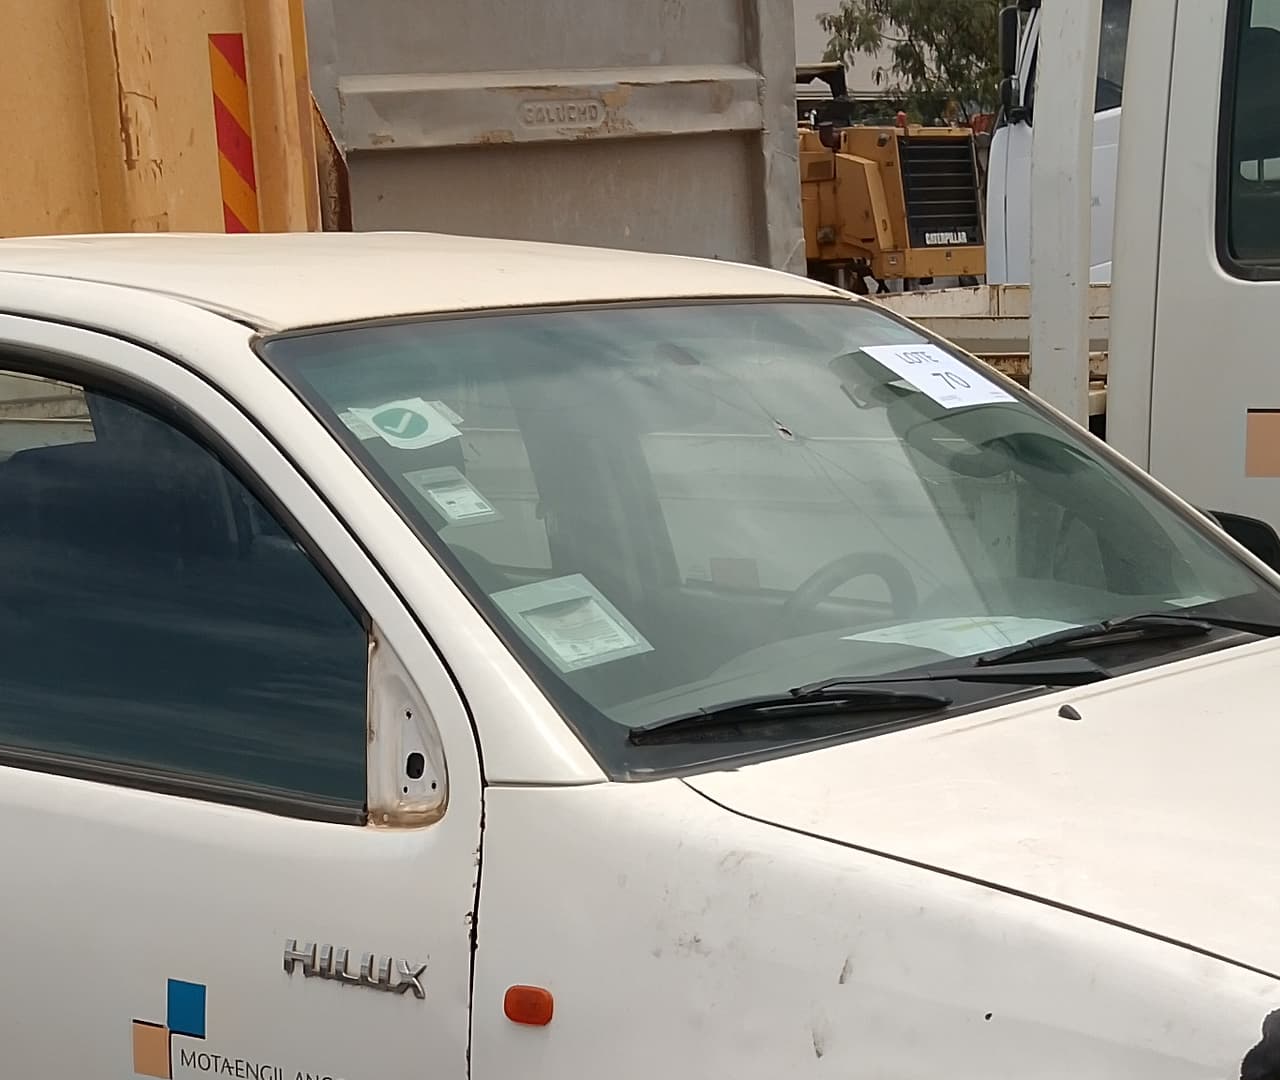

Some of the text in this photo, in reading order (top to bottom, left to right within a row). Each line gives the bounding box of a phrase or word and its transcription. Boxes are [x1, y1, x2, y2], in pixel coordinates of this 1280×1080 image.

[895, 351, 939, 365] LOTE
[931, 371, 971, 390] 70
[283, 937, 428, 1000] HILUX
